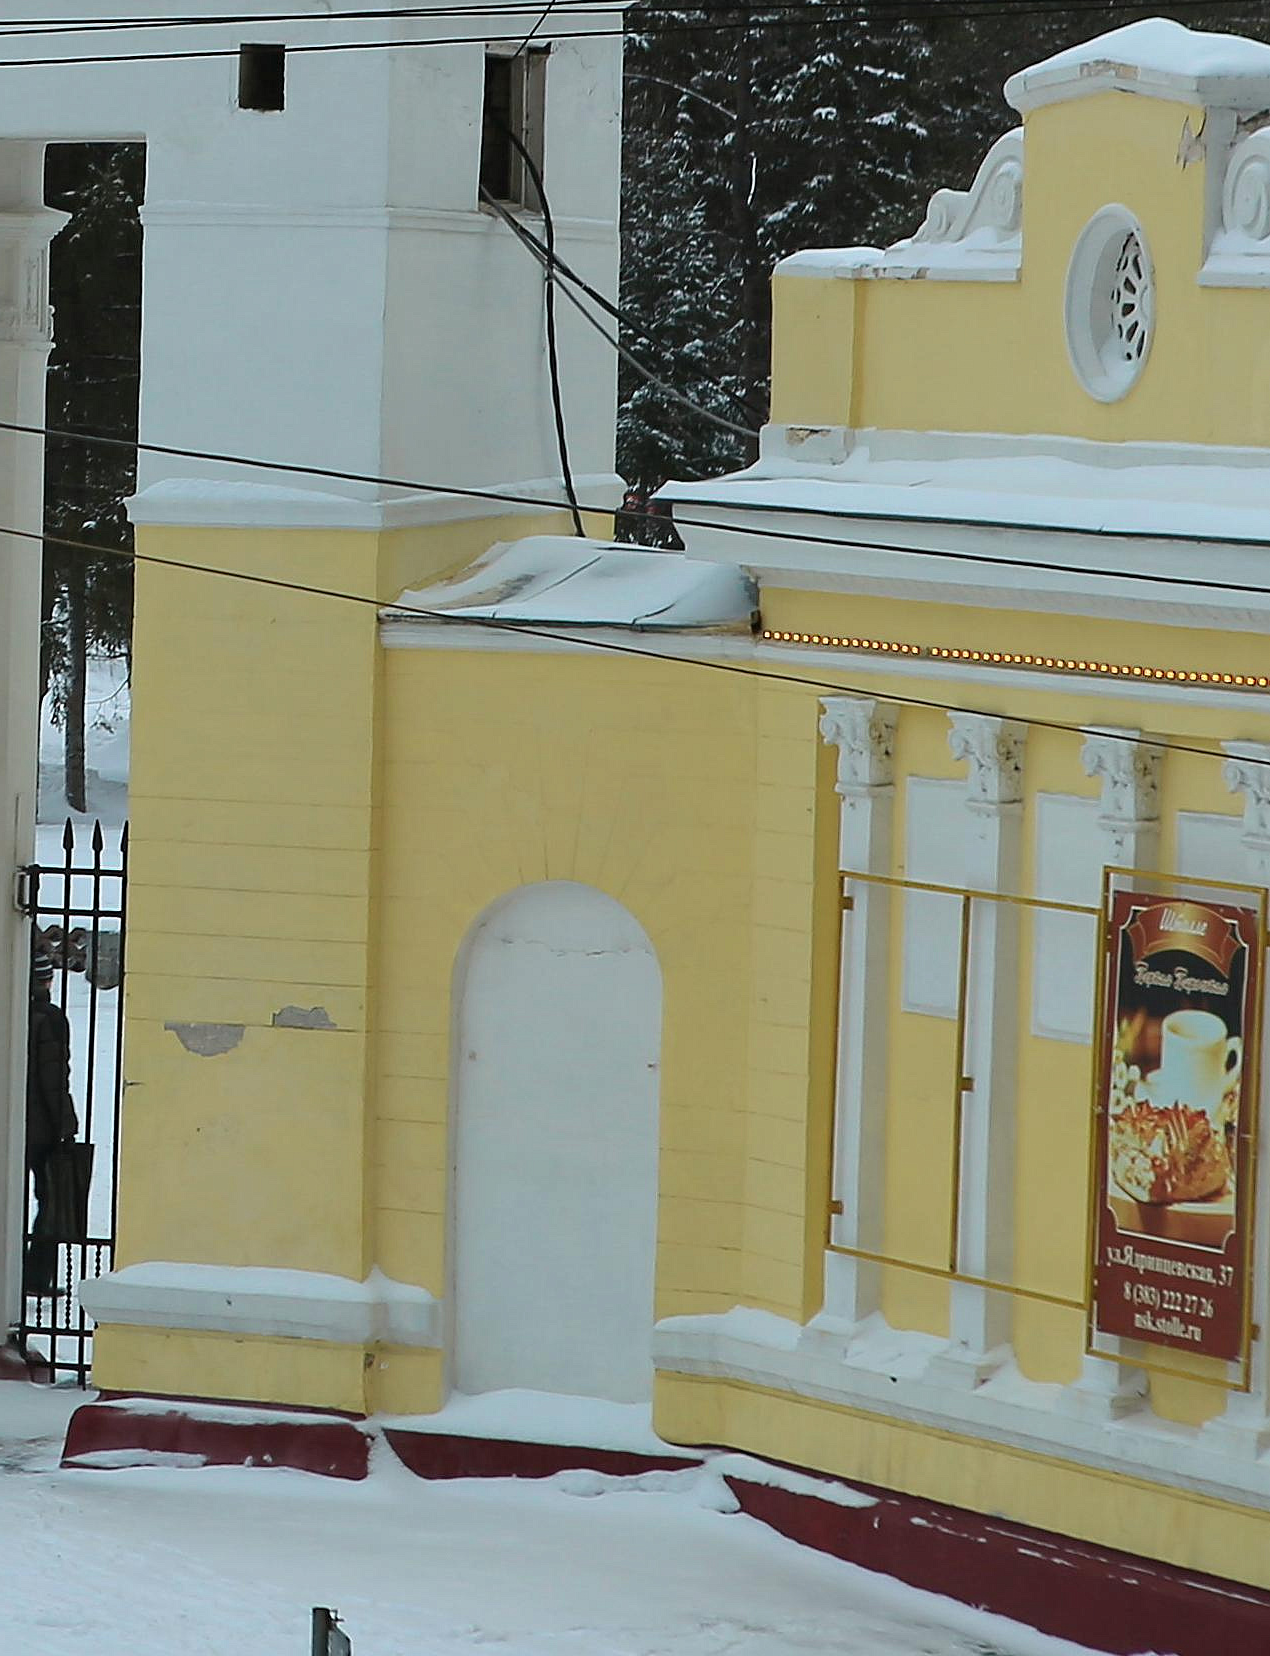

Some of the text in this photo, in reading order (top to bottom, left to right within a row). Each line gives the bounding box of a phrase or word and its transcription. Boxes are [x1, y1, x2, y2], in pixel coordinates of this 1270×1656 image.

[1218, 1263, 1234, 1287] 37
[1123, 1280, 1214, 1319] 8 (383) 222 27 26
